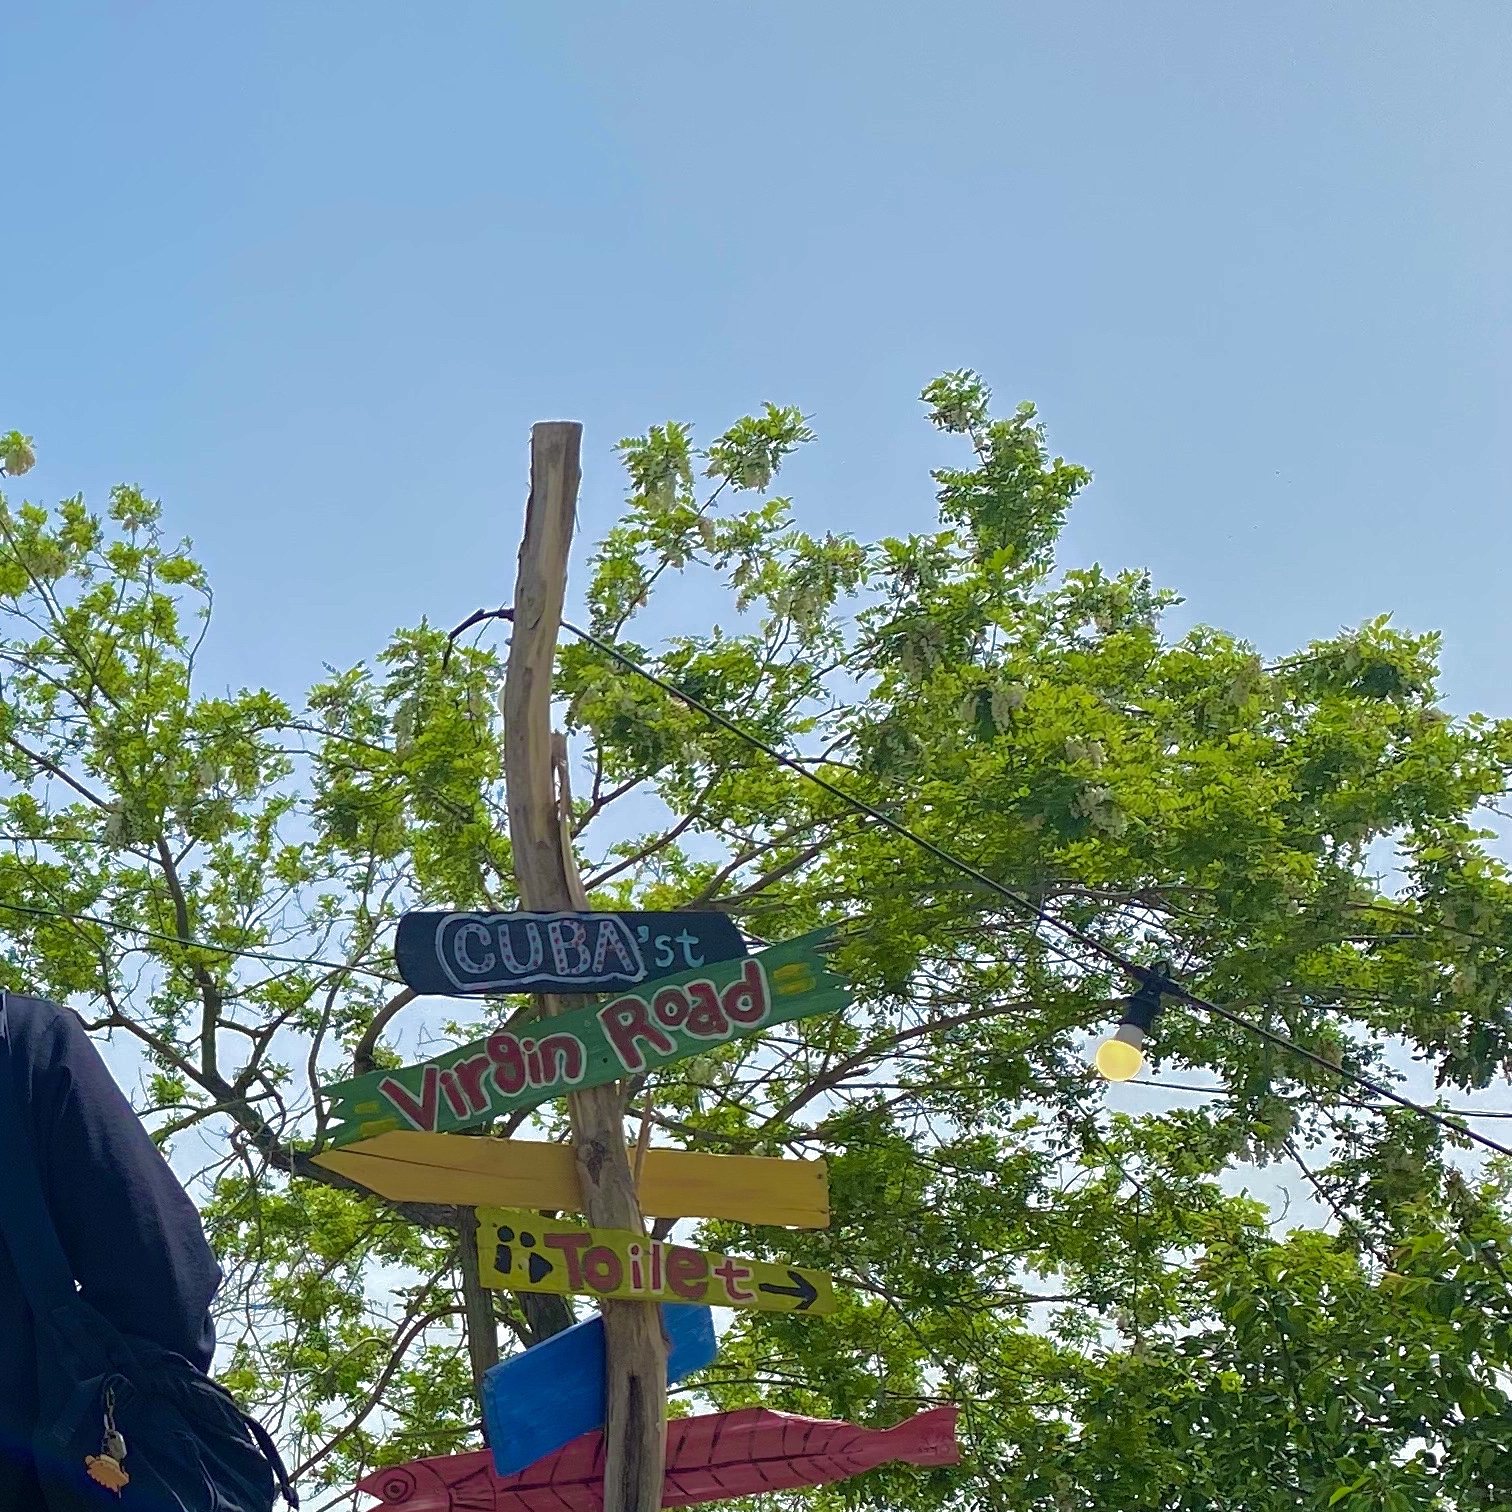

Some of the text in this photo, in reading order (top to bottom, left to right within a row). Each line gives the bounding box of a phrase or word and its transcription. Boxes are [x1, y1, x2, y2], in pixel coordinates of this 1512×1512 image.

[453, 919, 705, 975] CUBA'st
[378, 958, 770, 1131] Virgin Road
[544, 1232, 756, 1303] Toilet
